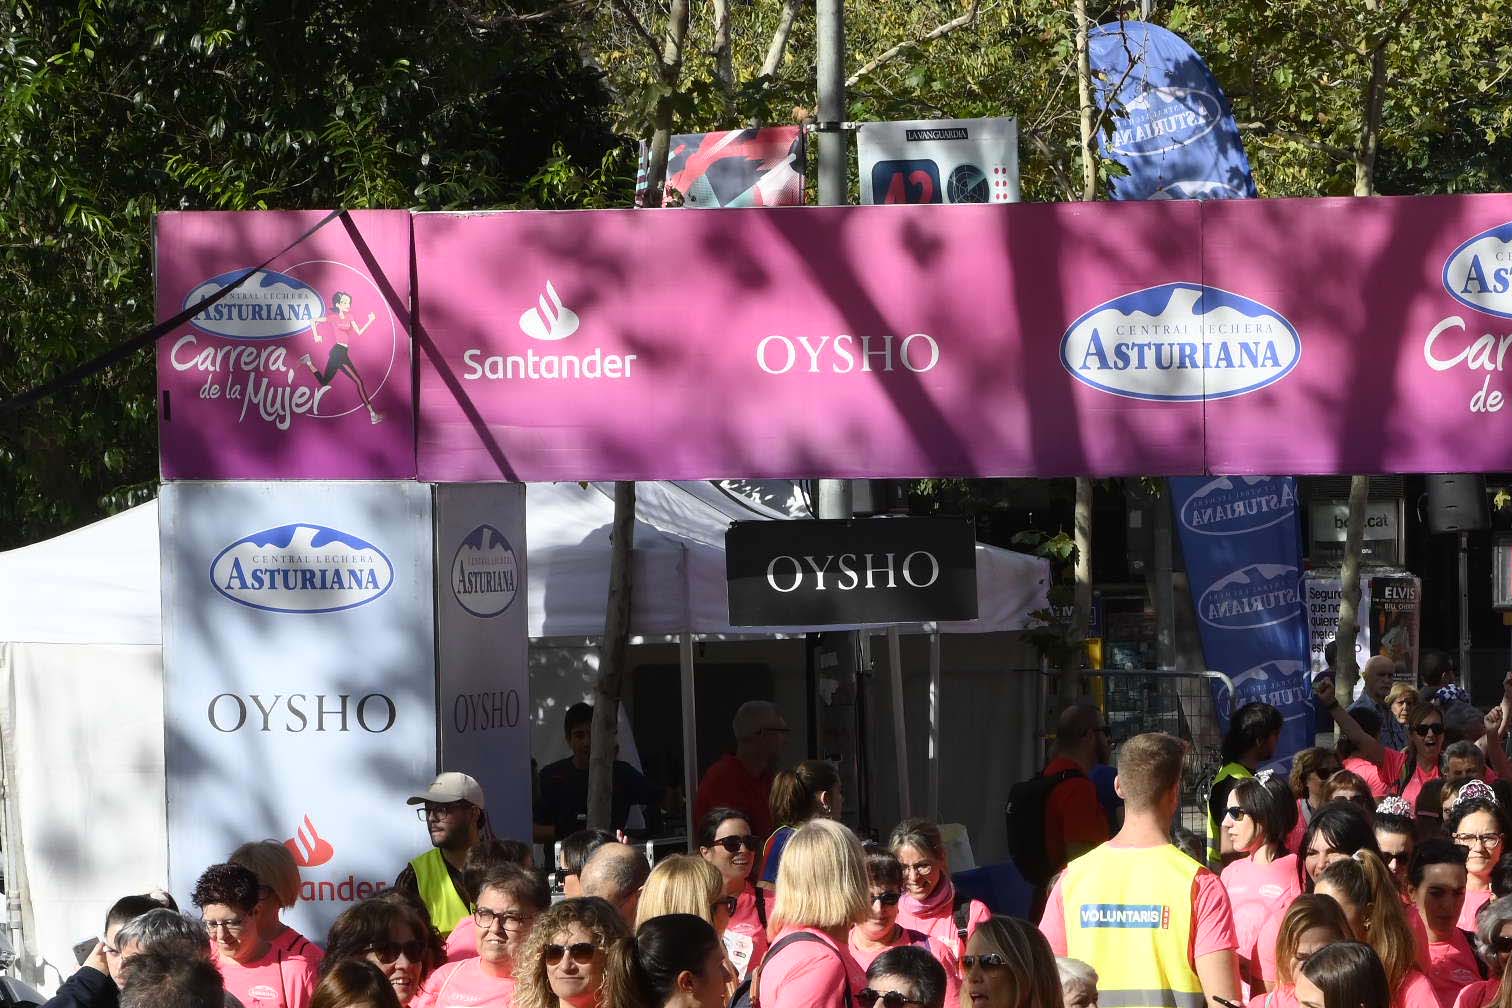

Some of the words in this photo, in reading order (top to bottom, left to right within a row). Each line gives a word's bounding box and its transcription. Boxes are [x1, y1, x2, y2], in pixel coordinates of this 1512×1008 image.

[1115, 324, 1189, 336] CENTRAL
[170, 335, 287, 371] Carrera
[463, 348, 637, 381] Santander
[755, 331, 940, 375] OYSHO
[1080, 327, 1283, 371] ASTURIANA
[200, 374, 220, 399] de
[226, 374, 241, 399] la
[239, 368, 332, 430] Mujer
[1469, 373, 1504, 413] de
[224, 556, 380, 591] ASTURIANA
[252, 555, 314, 564] CENTRAL
[315, 554, 374, 564] LECHERA
[456, 559, 515, 594] ASTURIANA
[765, 551, 940, 593] OYSHO
[1310, 603, 1326, 615] que
[1384, 586, 1416, 600] ELVIS
[207, 693, 397, 733] OYSHO
[453, 689, 520, 734] OYSHO
[1081, 910, 1160, 923] VOLUNTARIS
